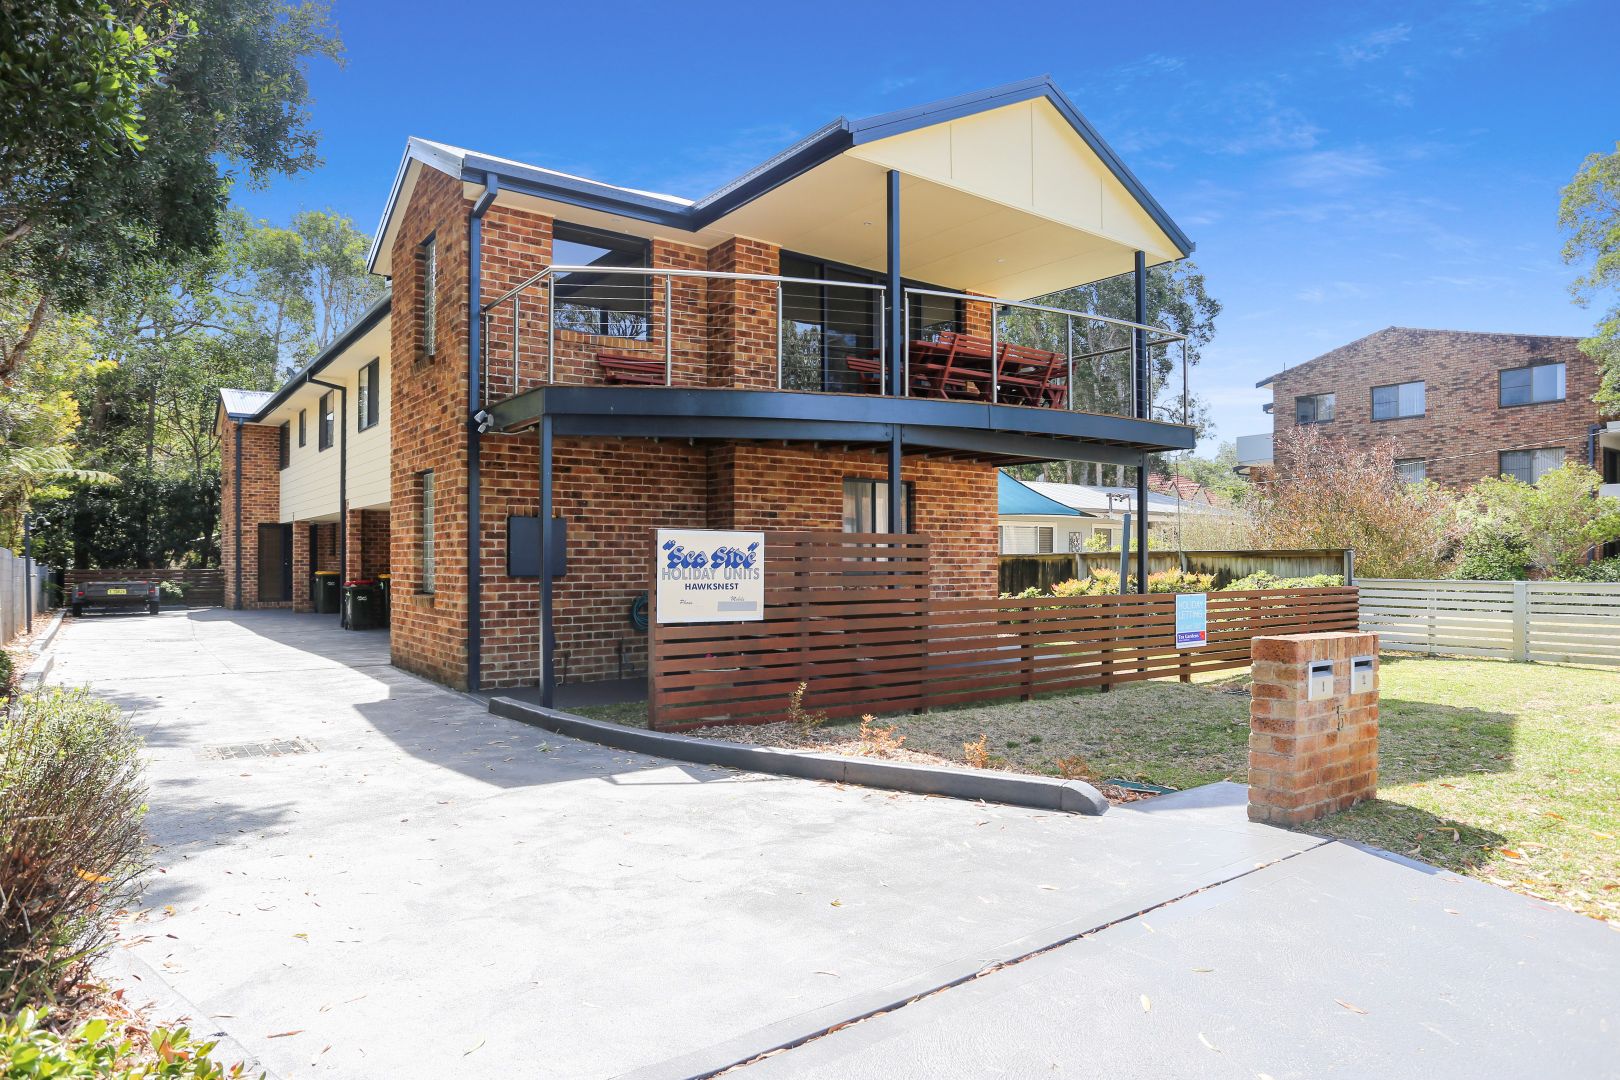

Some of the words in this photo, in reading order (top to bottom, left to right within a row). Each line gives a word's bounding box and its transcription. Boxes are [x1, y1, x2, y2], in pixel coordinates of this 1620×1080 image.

[661, 568, 717, 580] HOLIDAY
[723, 567, 760, 580] UNITS
[684, 582, 739, 591] HAWKSNEST
